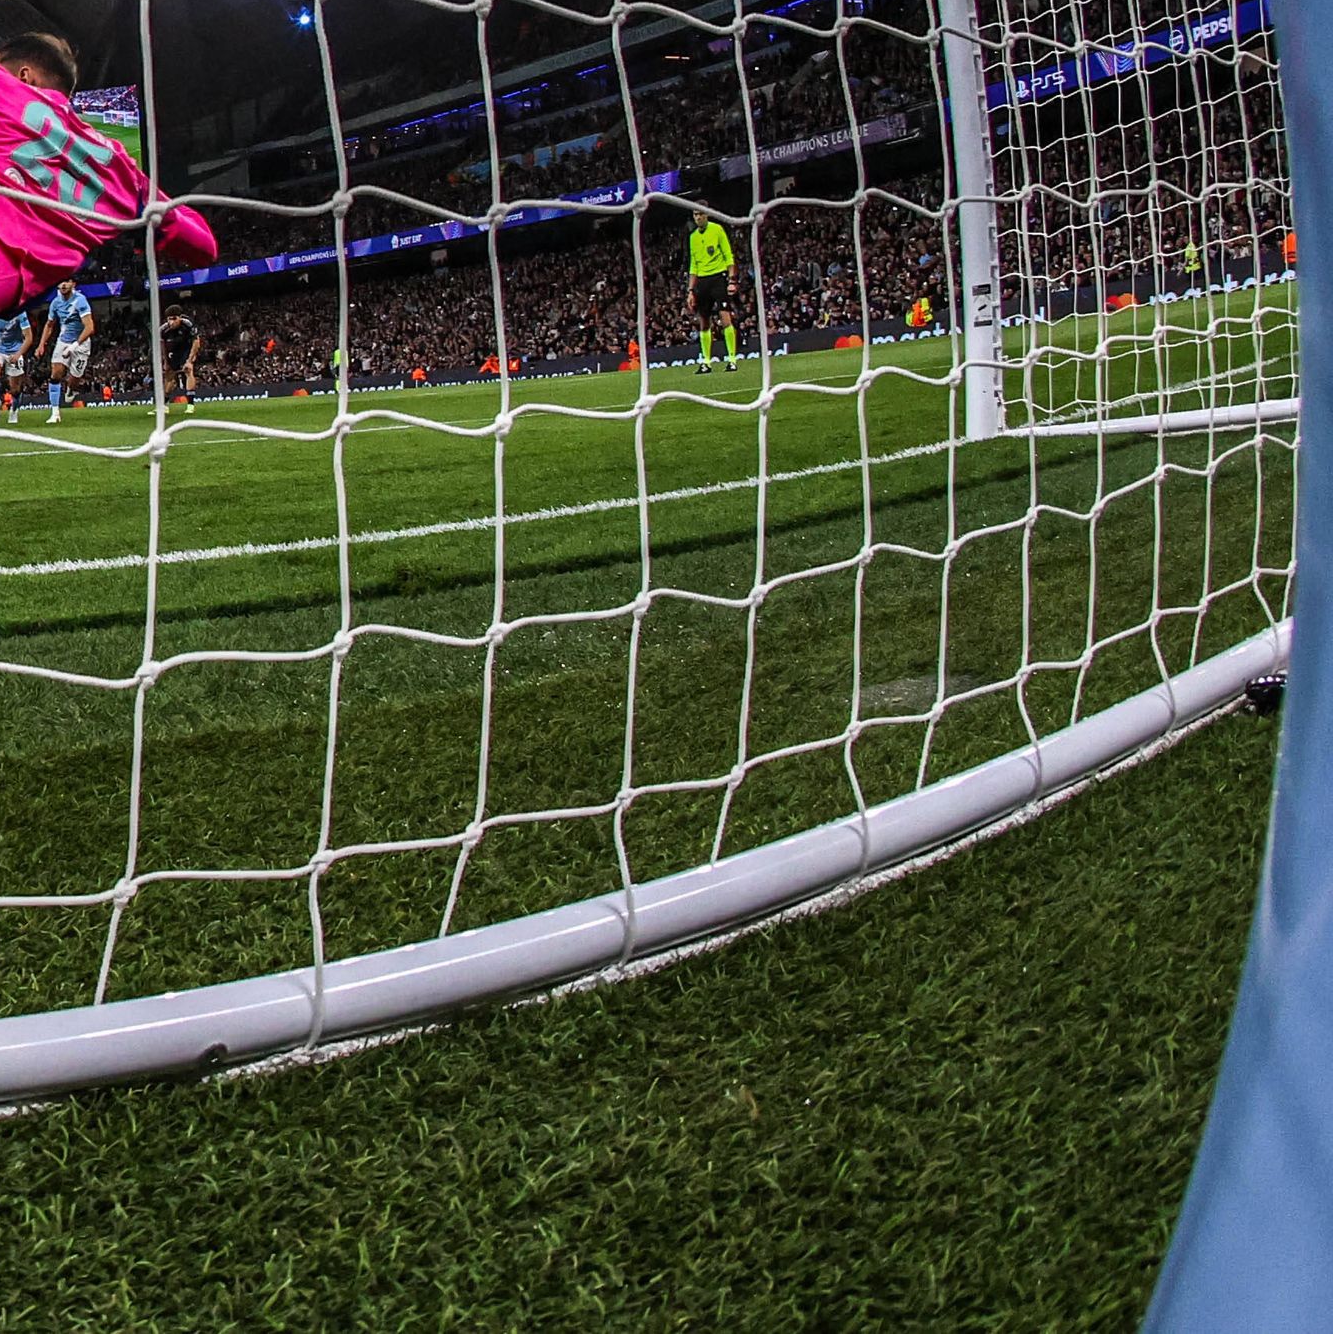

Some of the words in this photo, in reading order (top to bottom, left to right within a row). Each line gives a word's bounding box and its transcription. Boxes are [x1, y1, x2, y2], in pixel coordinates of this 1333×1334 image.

[1193, 16, 1232, 42] PEPSI
[773, 134, 829, 160] CHAMPIONS
[10, 101, 114, 223] 25
